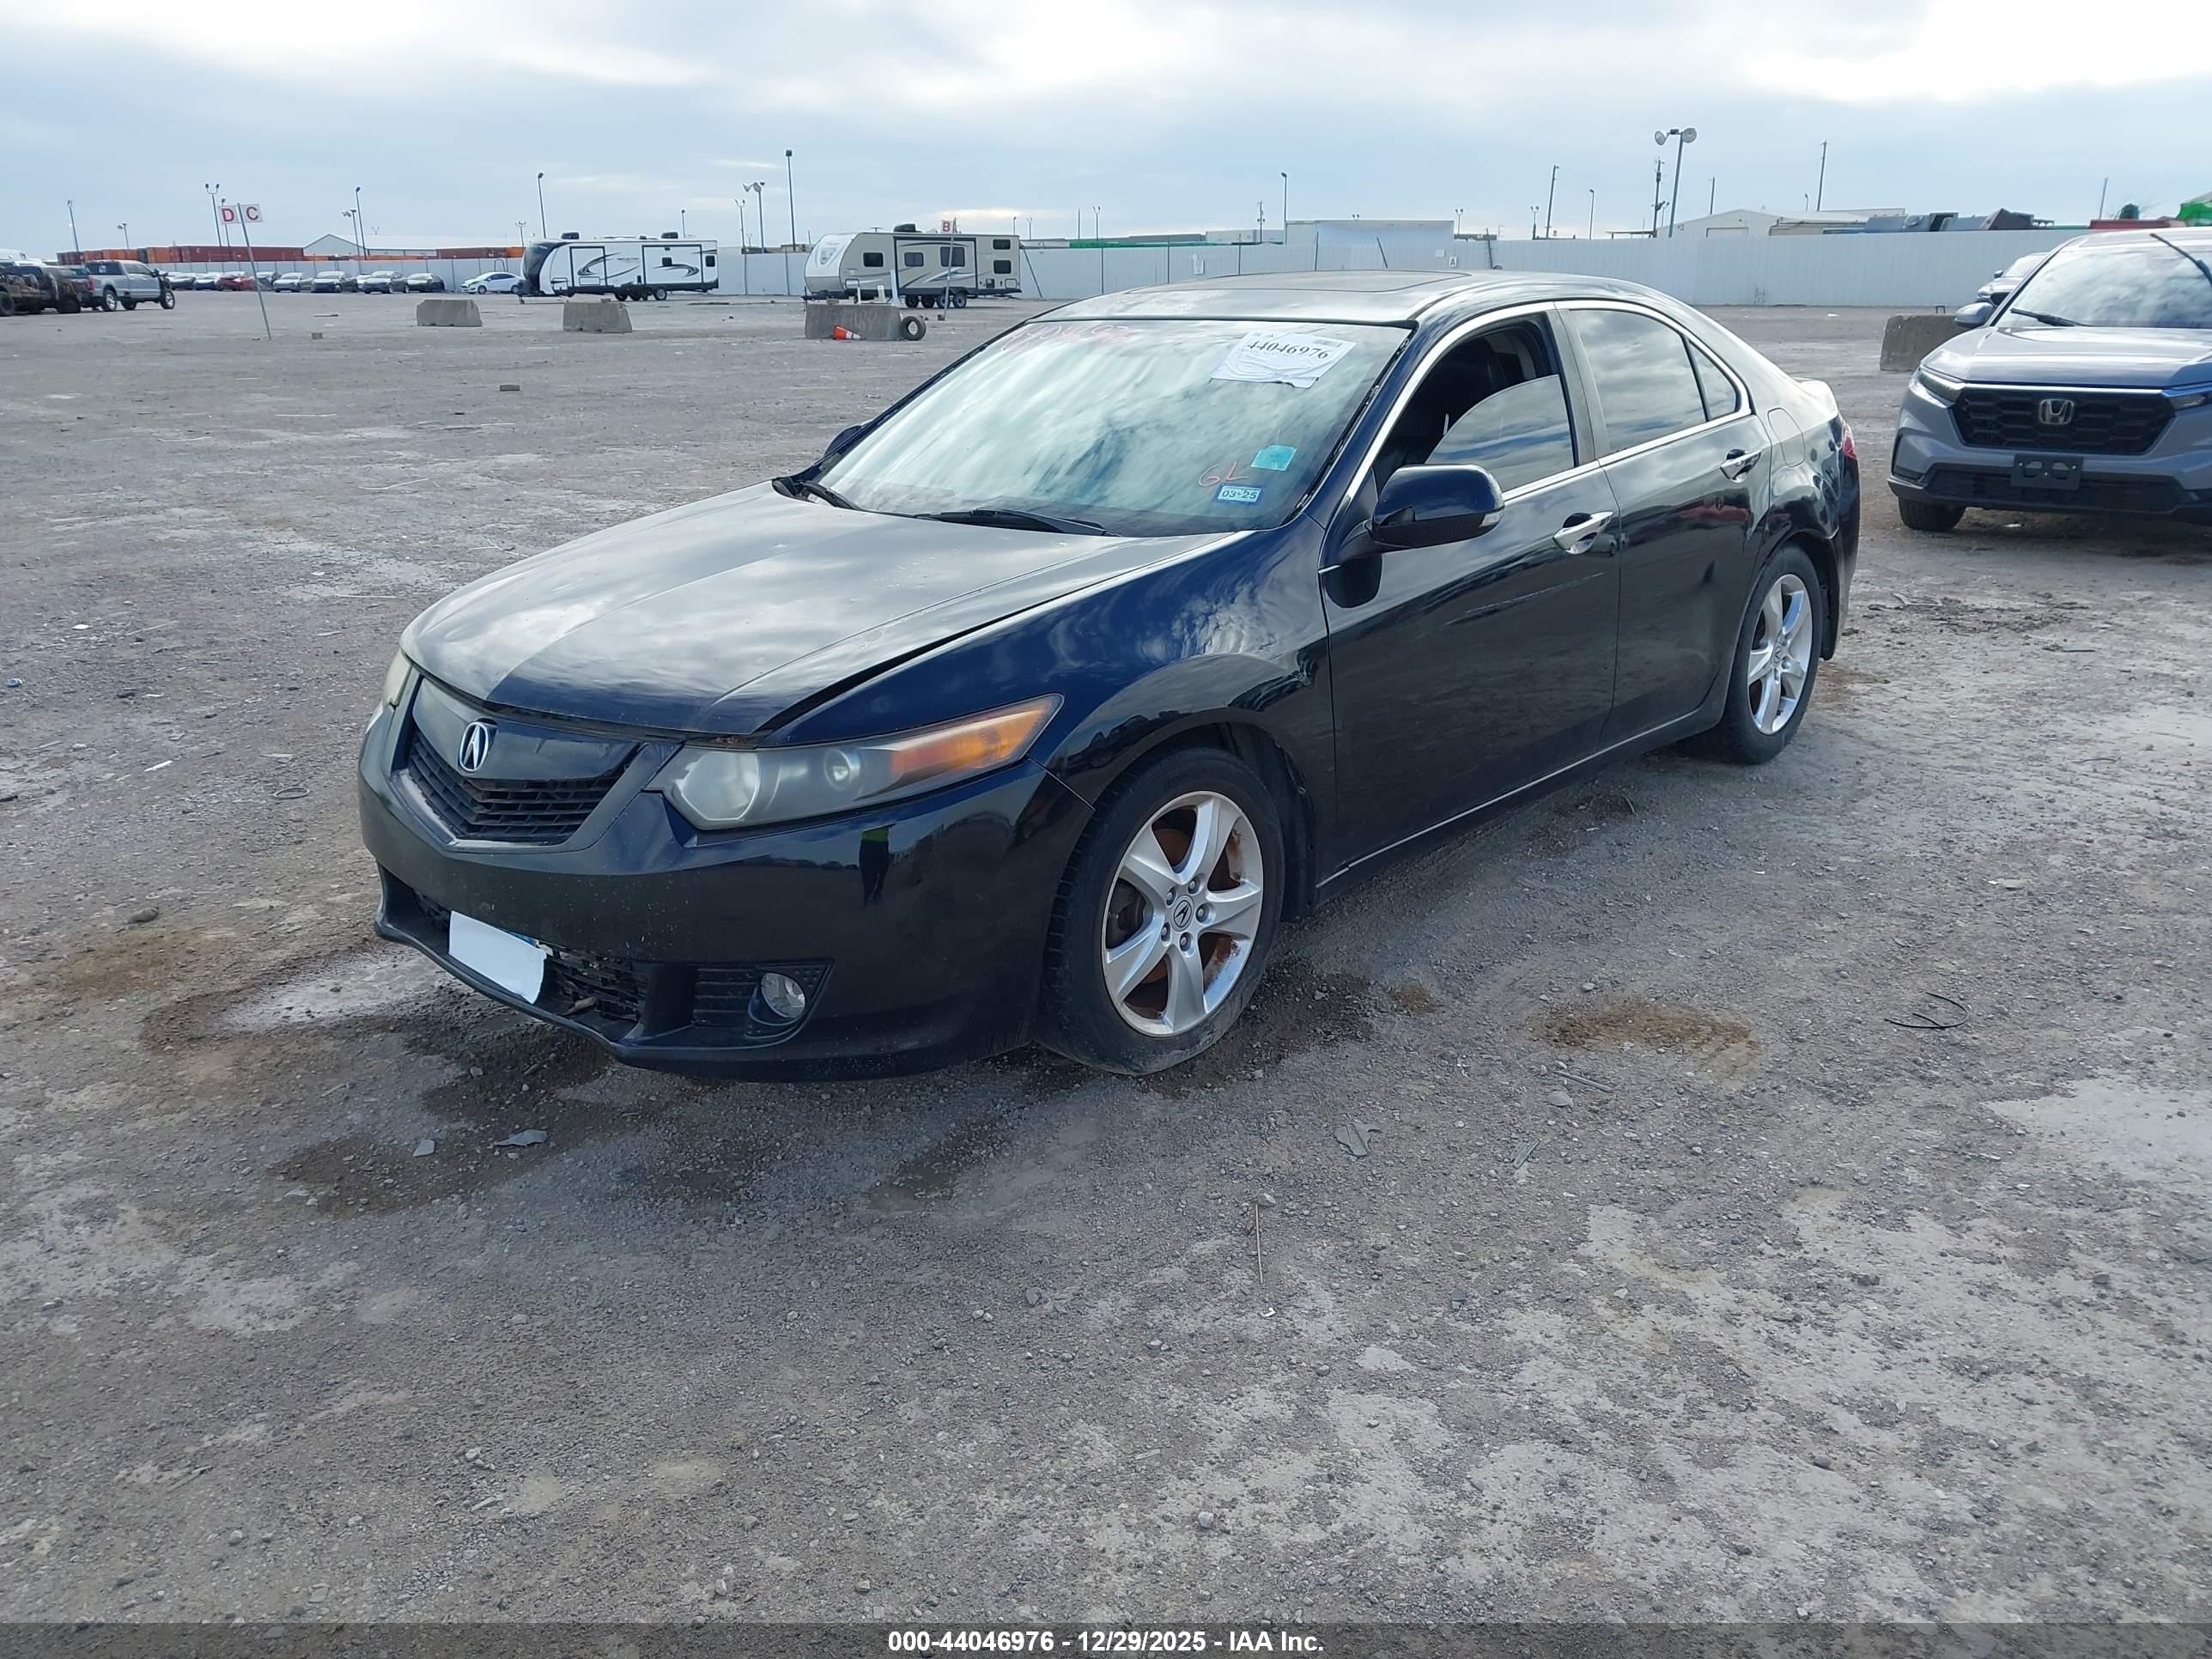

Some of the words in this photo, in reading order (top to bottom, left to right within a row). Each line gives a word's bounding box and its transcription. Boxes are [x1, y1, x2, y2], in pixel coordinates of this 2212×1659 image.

[222, 208, 234, 222] D
[246, 206, 258, 221] C
[1247, 340, 1331, 360] 44046976
